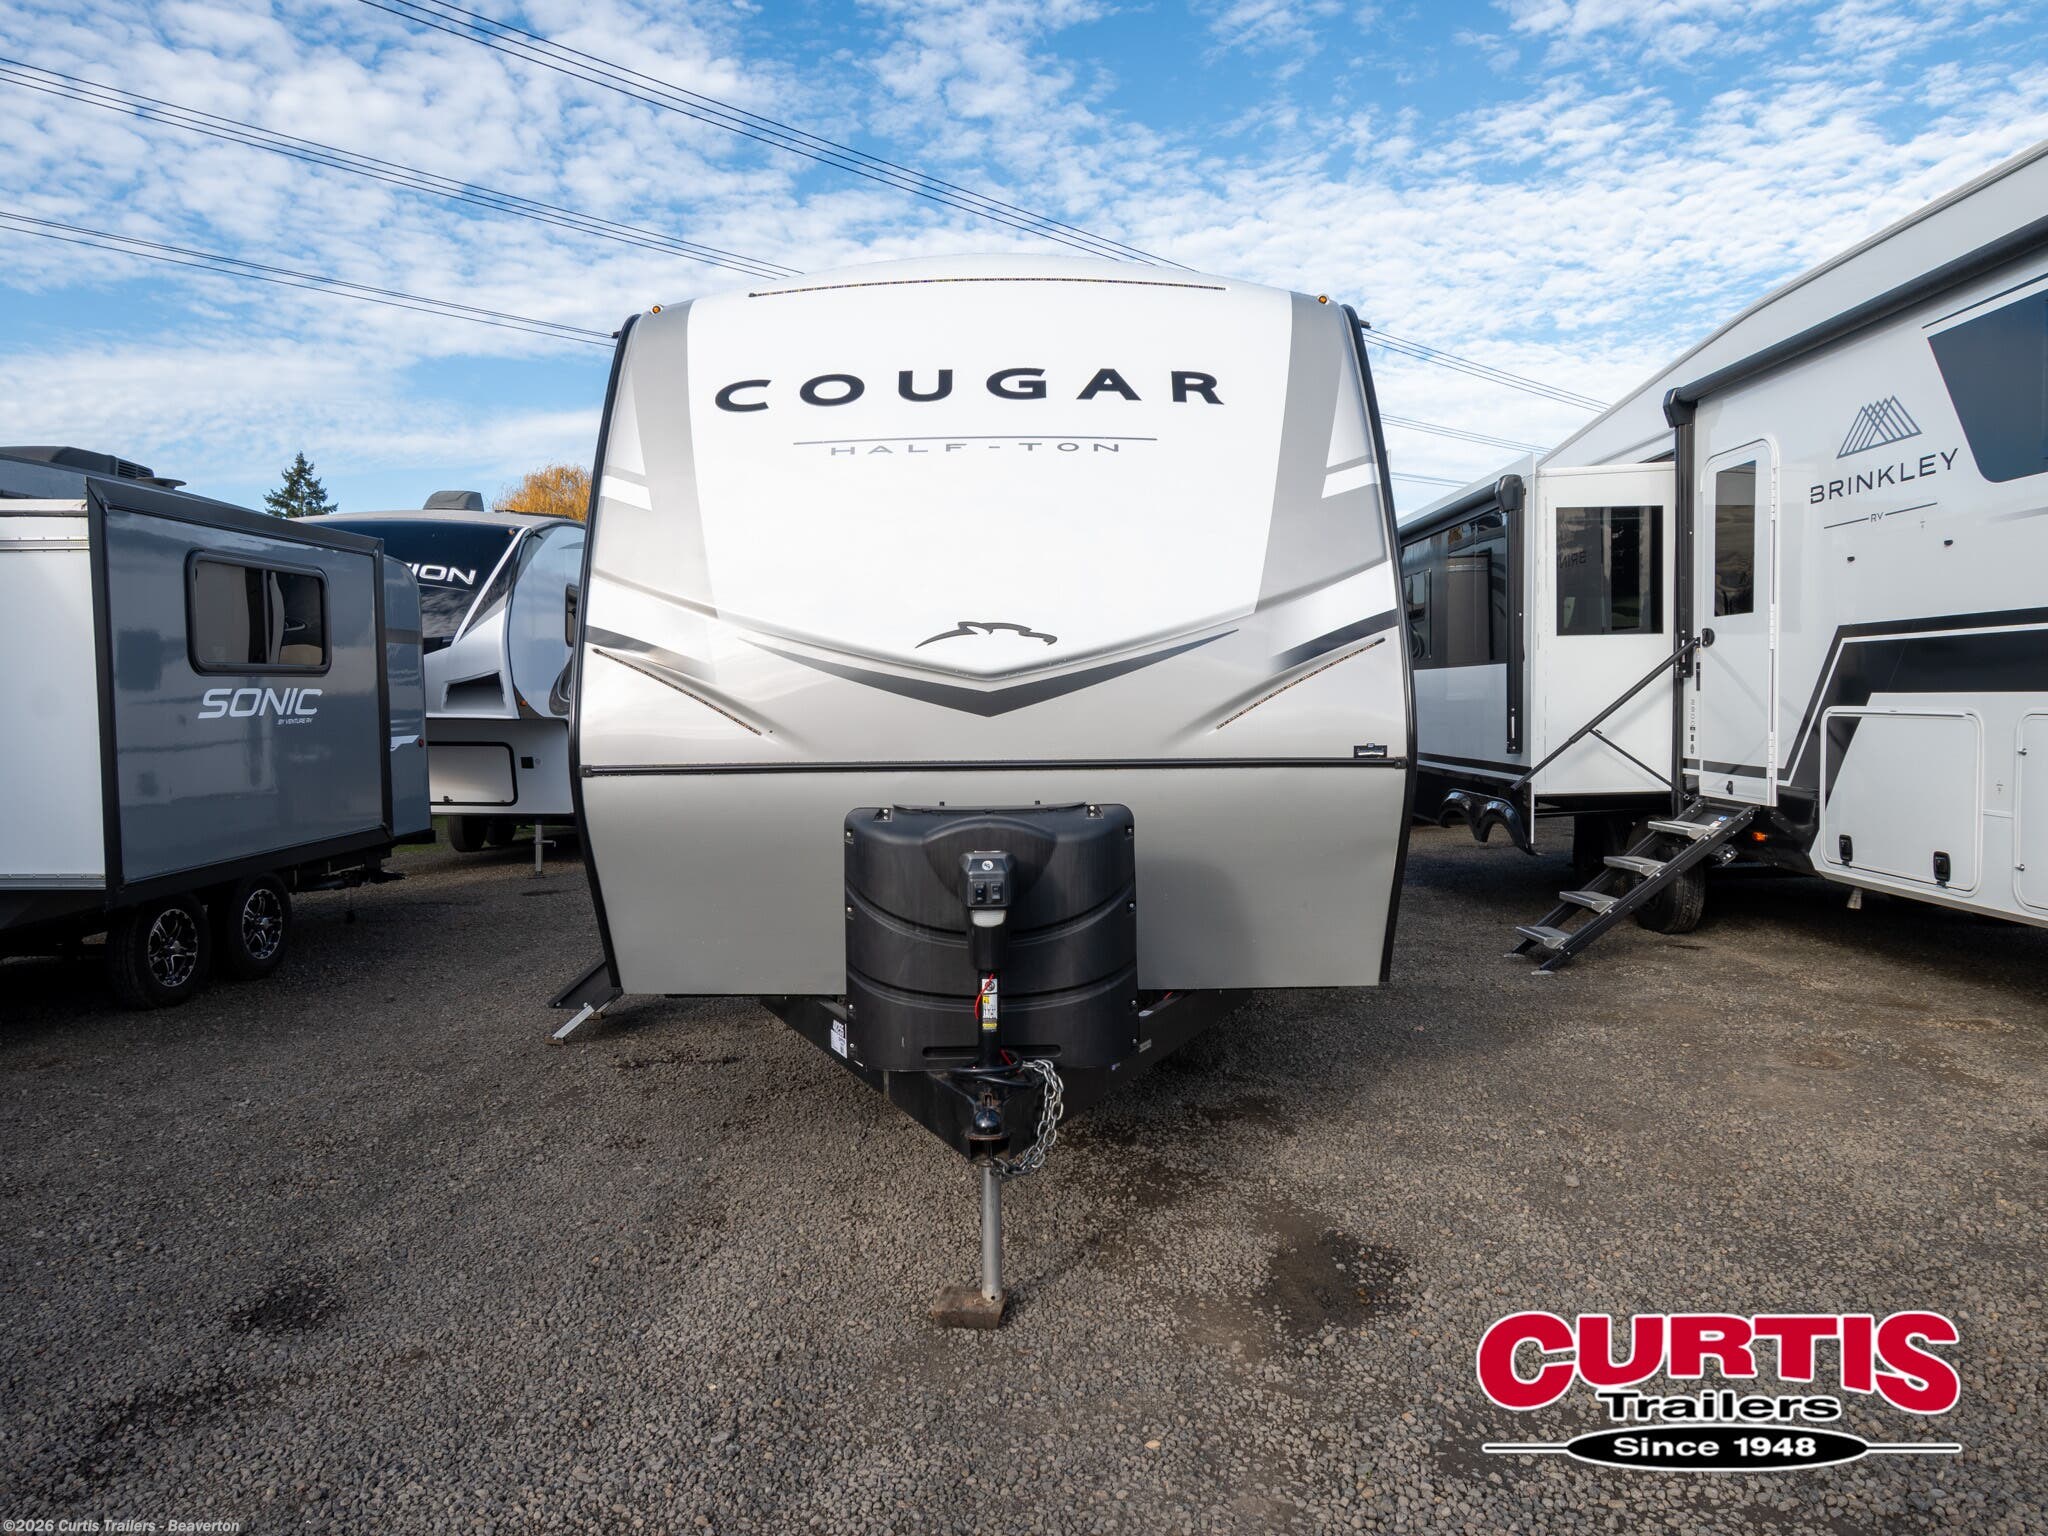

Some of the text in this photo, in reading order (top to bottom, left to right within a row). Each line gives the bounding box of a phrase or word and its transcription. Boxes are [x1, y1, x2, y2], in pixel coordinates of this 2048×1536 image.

[714, 368, 1225, 413] COUGAR
[1810, 447, 1959, 505] BRINKLEY
[1870, 512, 1884, 523] RV
[406, 563, 477, 585] ION
[198, 687, 323, 719] SONIC
